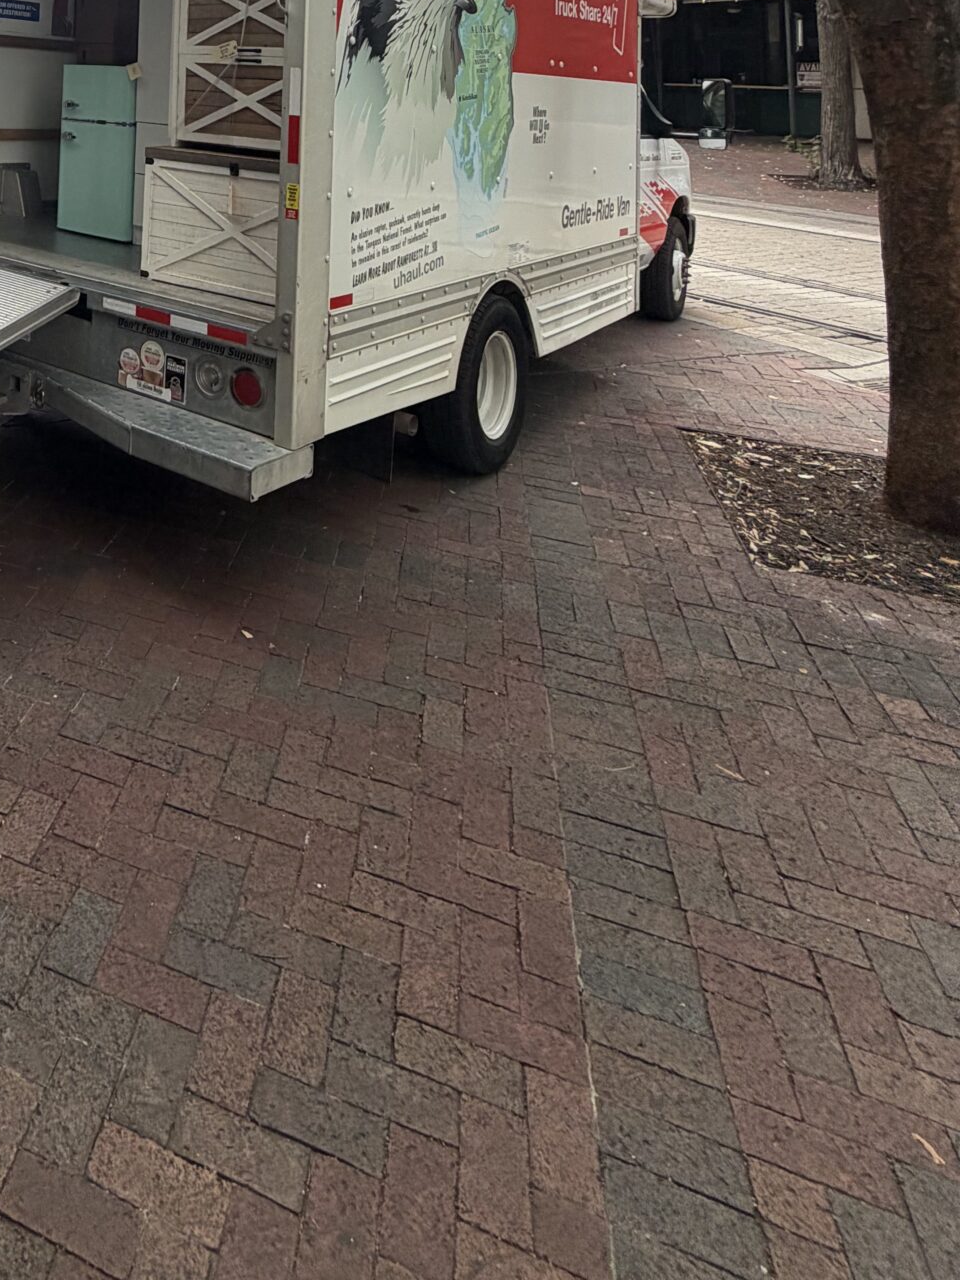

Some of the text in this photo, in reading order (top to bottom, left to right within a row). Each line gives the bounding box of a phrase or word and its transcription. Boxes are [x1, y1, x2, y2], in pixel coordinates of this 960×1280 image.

[579, 0, 601, 23] Share
[602, 3, 618, 28] 24/7
[351, 211, 361, 224] DID
[362, 207, 373, 220] YOU
[561, 195, 631, 229] Gentle-Ride Van
[352, 270, 368, 288] LEARN
[368, 265, 381, 281] MORE
[381, 258, 397, 275] ABOUT
[393, 255, 445, 289] uhaul.com
[119, 317, 141, 333] Don't
[141, 323, 169, 340] Forget
[171, 331, 191, 345] Your
[191, 335, 226, 356] Moving
